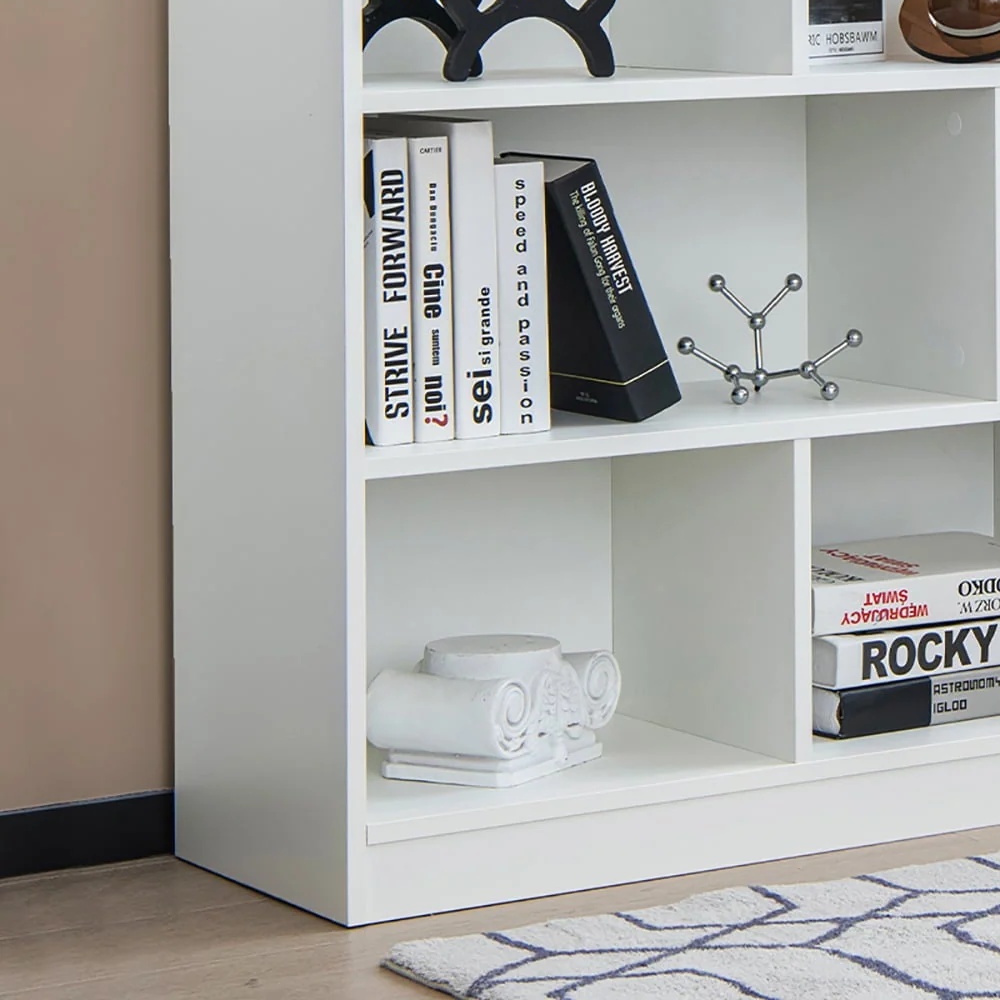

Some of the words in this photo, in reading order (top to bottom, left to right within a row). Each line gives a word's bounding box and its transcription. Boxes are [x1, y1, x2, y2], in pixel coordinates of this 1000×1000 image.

[826, 30, 878, 45] HOBSBAWM
[381, 169, 407, 302] FORWARD
[515, 179, 527, 253] speed
[569, 190, 580, 206] The
[583, 227, 595, 237] of
[593, 255, 606, 277] Gong
[601, 275, 612, 288] for
[580, 181, 611, 234] BLOODY
[600, 234, 633, 295] HARVEST
[423, 263, 445, 319] Cine
[516, 265, 529, 307] and
[478, 287, 494, 345] grande
[384, 326, 409, 419] STRIVE
[431, 329, 440, 366] suntem
[478, 351, 491, 365] si
[518, 319, 533, 424] passion
[424, 375, 449, 427] noi?
[466, 370, 493, 424] sei
[863, 589, 909, 606] ŚWIAT
[861, 624, 999, 681] ROCKY
[933, 699, 967, 714] IGLOO
